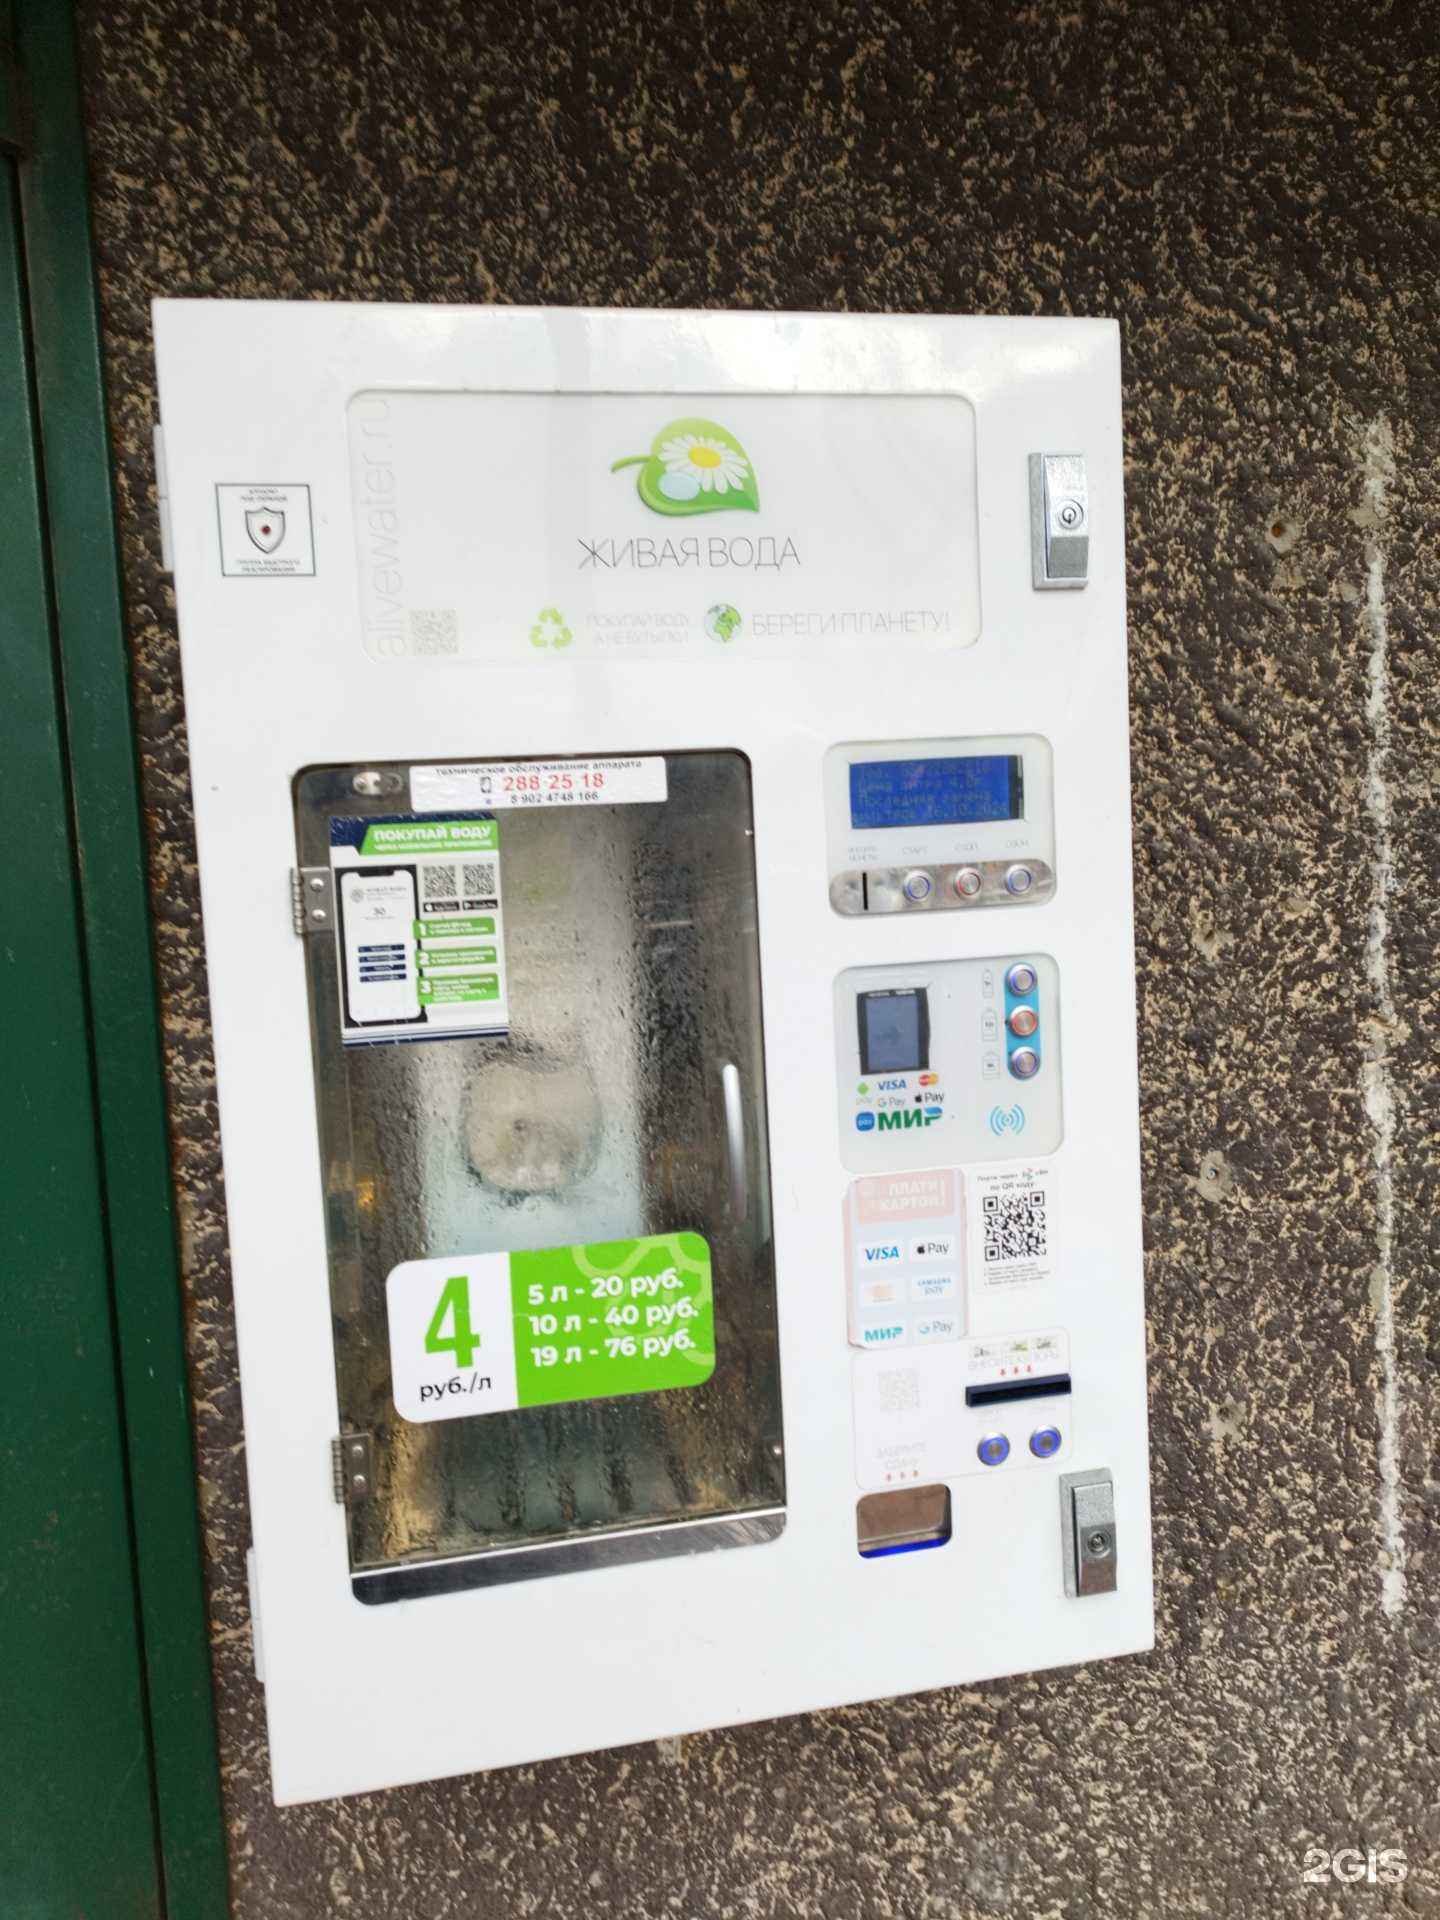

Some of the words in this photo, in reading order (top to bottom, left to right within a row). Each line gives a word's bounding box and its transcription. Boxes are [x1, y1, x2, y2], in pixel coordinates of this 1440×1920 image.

[577, 536, 700, 570] ЖИВАЯ
[708, 536, 802, 571] ВОДА
[503, 775, 540, 792] 288
[548, 773, 573, 789] 25
[583, 771, 604, 788] 18
[521, 793, 542, 803] 902
[373, 824, 448, 841] ПОКУПАЙ
[450, 825, 491, 840] ВОДУ
[419, 923, 427, 936] 1
[419, 952, 430, 965] 2
[420, 980, 432, 994] 3
[878, 1079, 906, 1090] VISA
[924, 1091, 944, 1104] Pay
[878, 1106, 943, 1131] МИР
[864, 1246, 900, 1261] VISA
[927, 1240, 949, 1255] Pay
[527, 1284, 545, 1306] 5
[549, 1287, 570, 1304] л
[590, 1276, 624, 1299] 20
[630, 1267, 684, 1297] руб.
[424, 1275, 481, 1369] 4
[530, 1313, 558, 1336] 10
[563, 1315, 583, 1334] л
[603, 1304, 639, 1328] 40
[646, 1296, 700, 1327] руб.
[864, 1326, 903, 1342] МИР
[531, 1345, 558, 1368] 19
[563, 1345, 583, 1365] л
[603, 1336, 638, 1359] 76
[642, 1328, 696, 1359] руб.
[419, 1372, 492, 1402] руб./л
